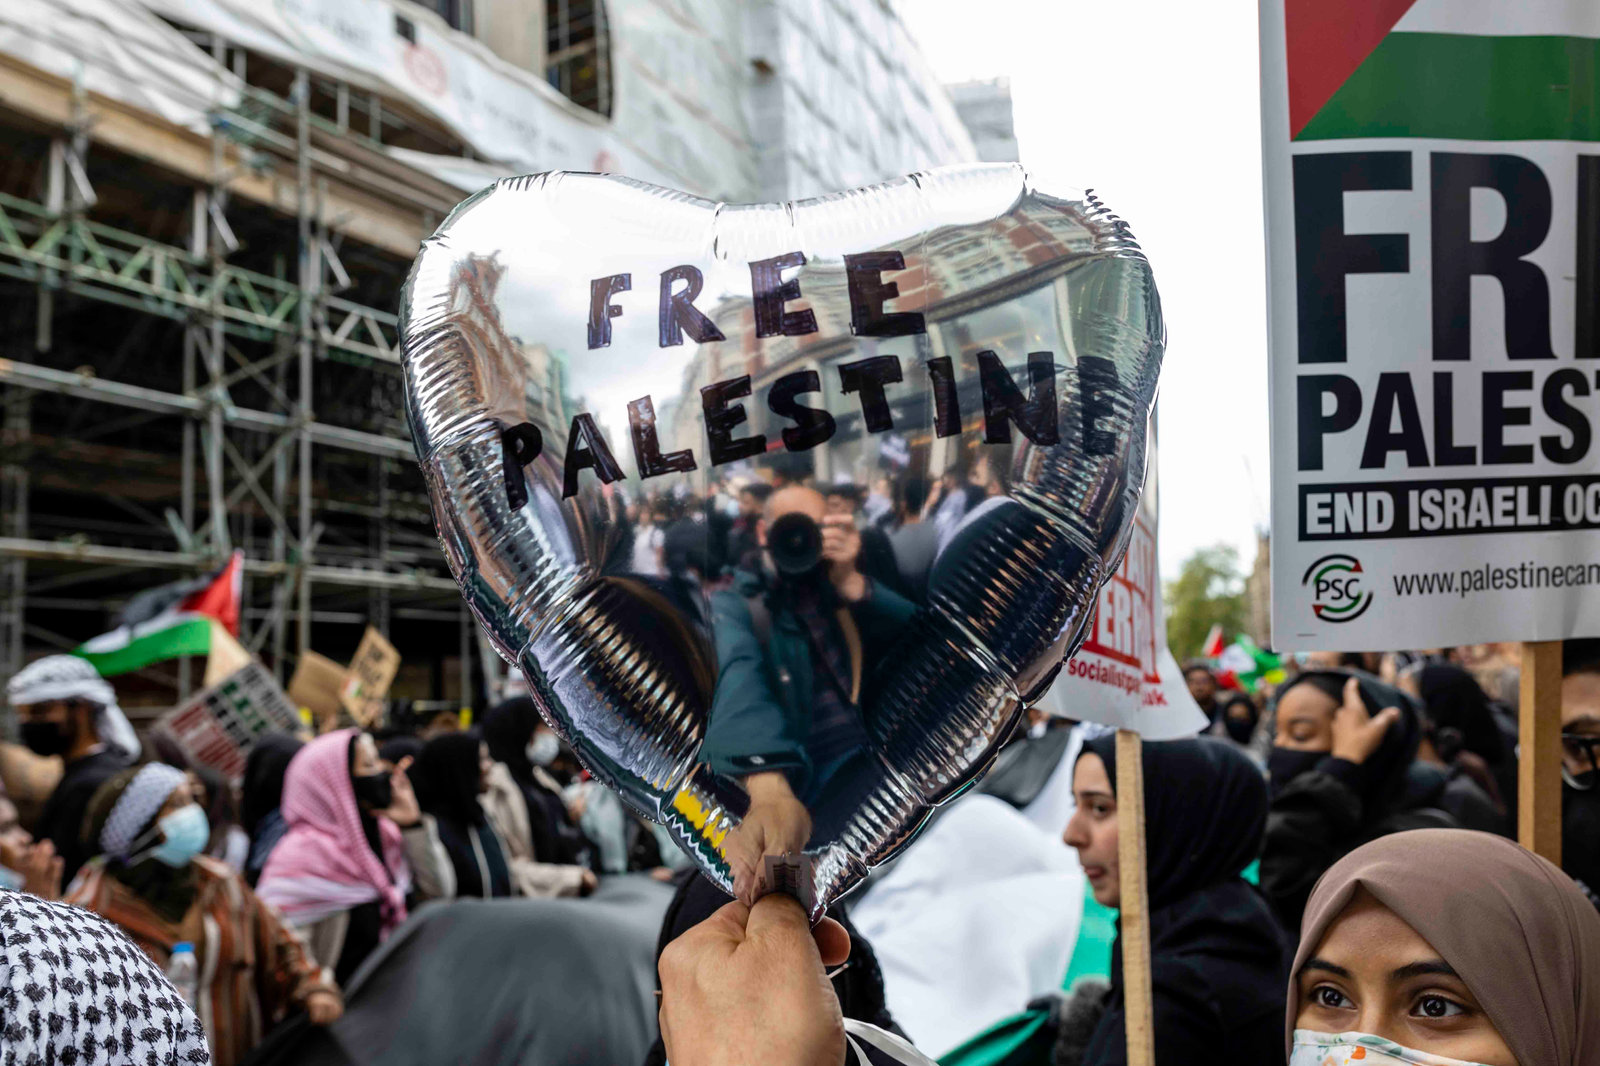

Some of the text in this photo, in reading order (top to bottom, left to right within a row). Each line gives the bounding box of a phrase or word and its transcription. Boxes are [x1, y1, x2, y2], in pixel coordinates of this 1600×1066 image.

[588, 251, 926, 349] FREE
[1292, 151, 1600, 363] FR
[501, 350, 1117, 512] PALESTINE
[1297, 368, 1600, 471] PALES
[1306, 491, 1395, 534] END
[1408, 485, 1552, 531] ISRAELI
[1316, 578, 1360, 601] PSC
